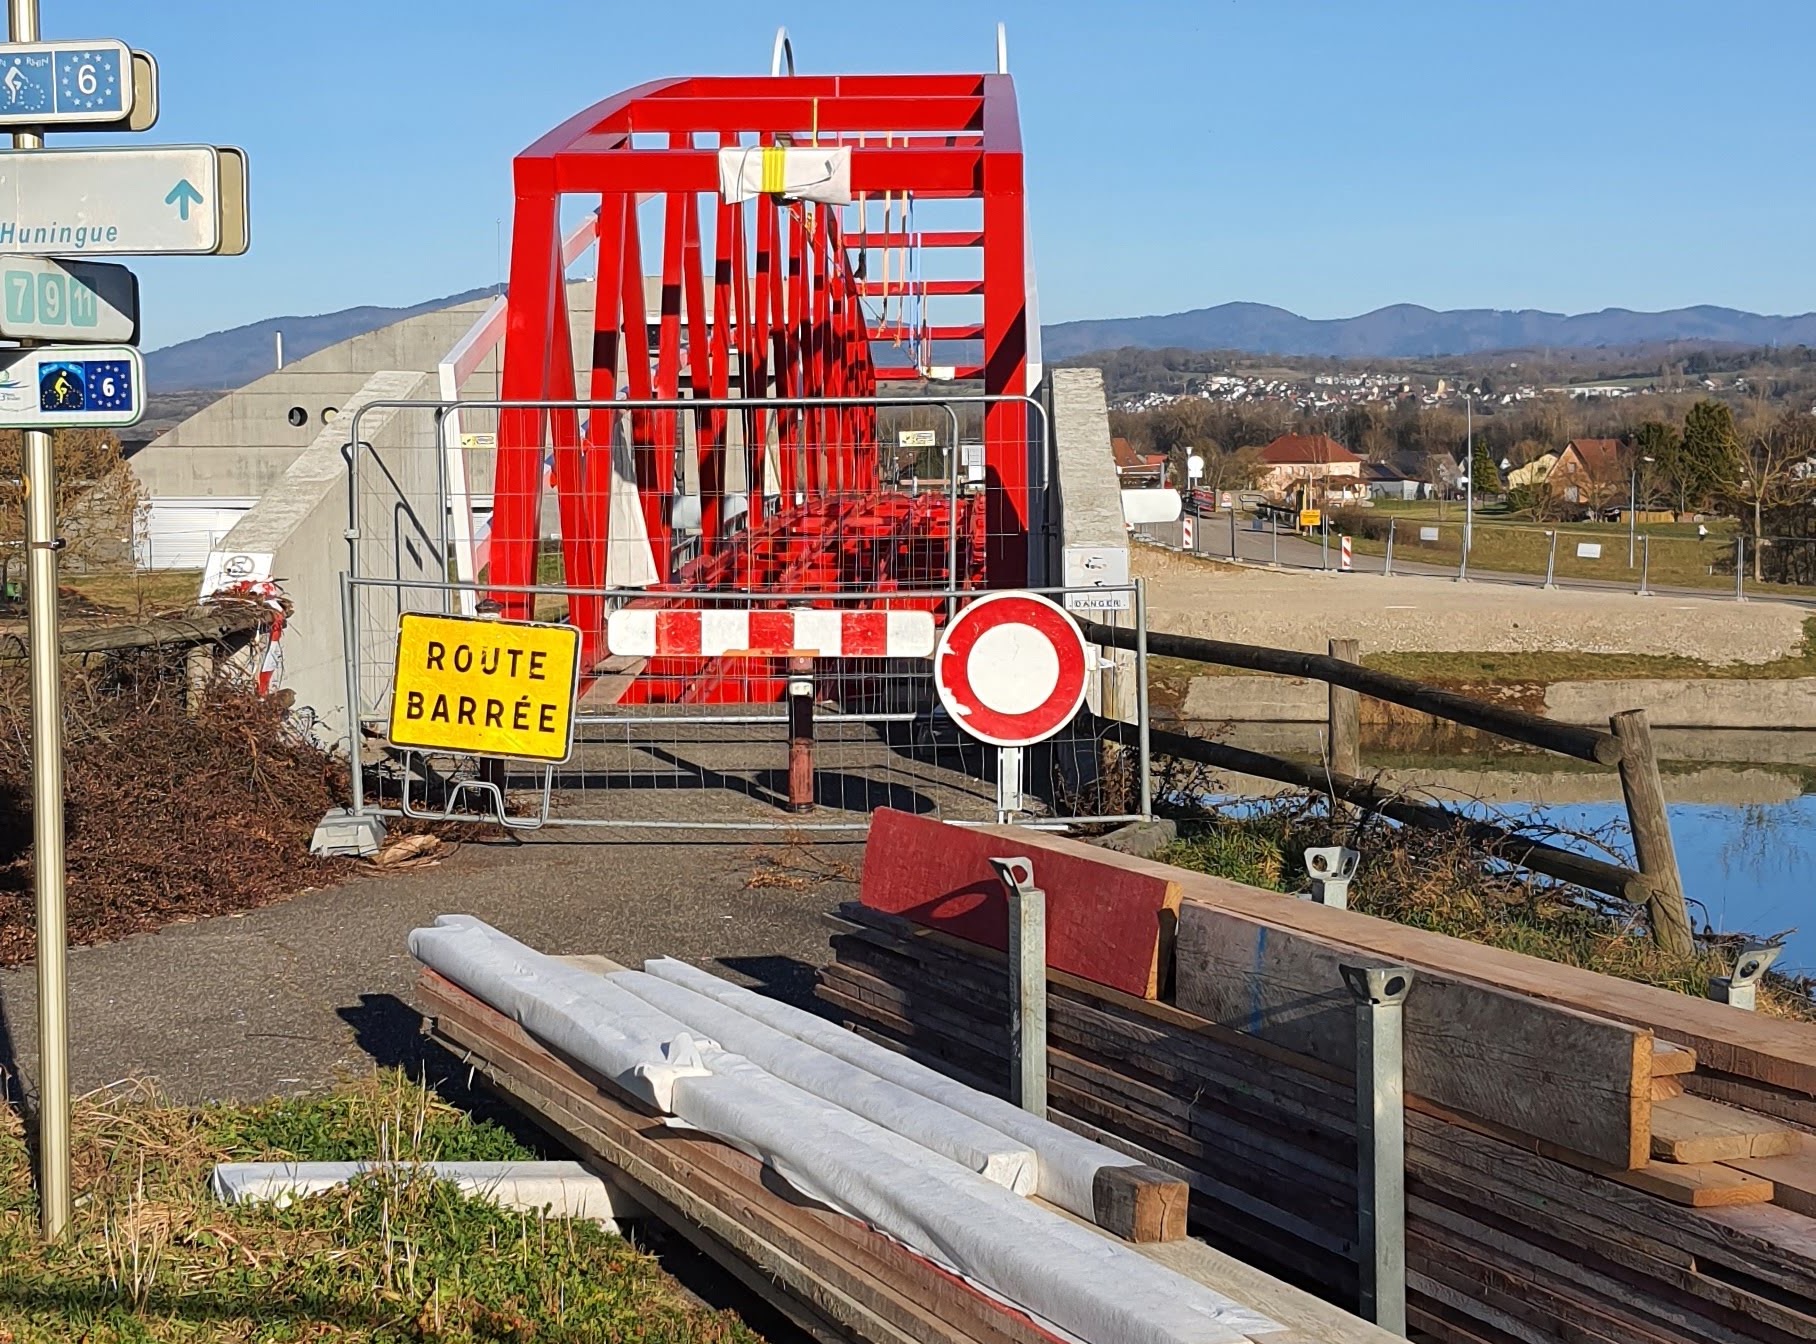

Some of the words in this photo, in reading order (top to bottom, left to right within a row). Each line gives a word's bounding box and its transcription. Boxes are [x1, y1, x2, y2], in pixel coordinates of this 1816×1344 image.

[78, 64, 97, 94] 6
[0, 222, 118, 248] Huningue
[13, 278, 28, 316] 7
[45, 280, 59, 318] 9
[74, 287, 93, 318] 11
[102, 377, 115, 397] 6
[1074, 599, 1121, 607] DANGER
[426, 641, 547, 680] ROUTE
[406, 690, 557, 733] BARRÉE
